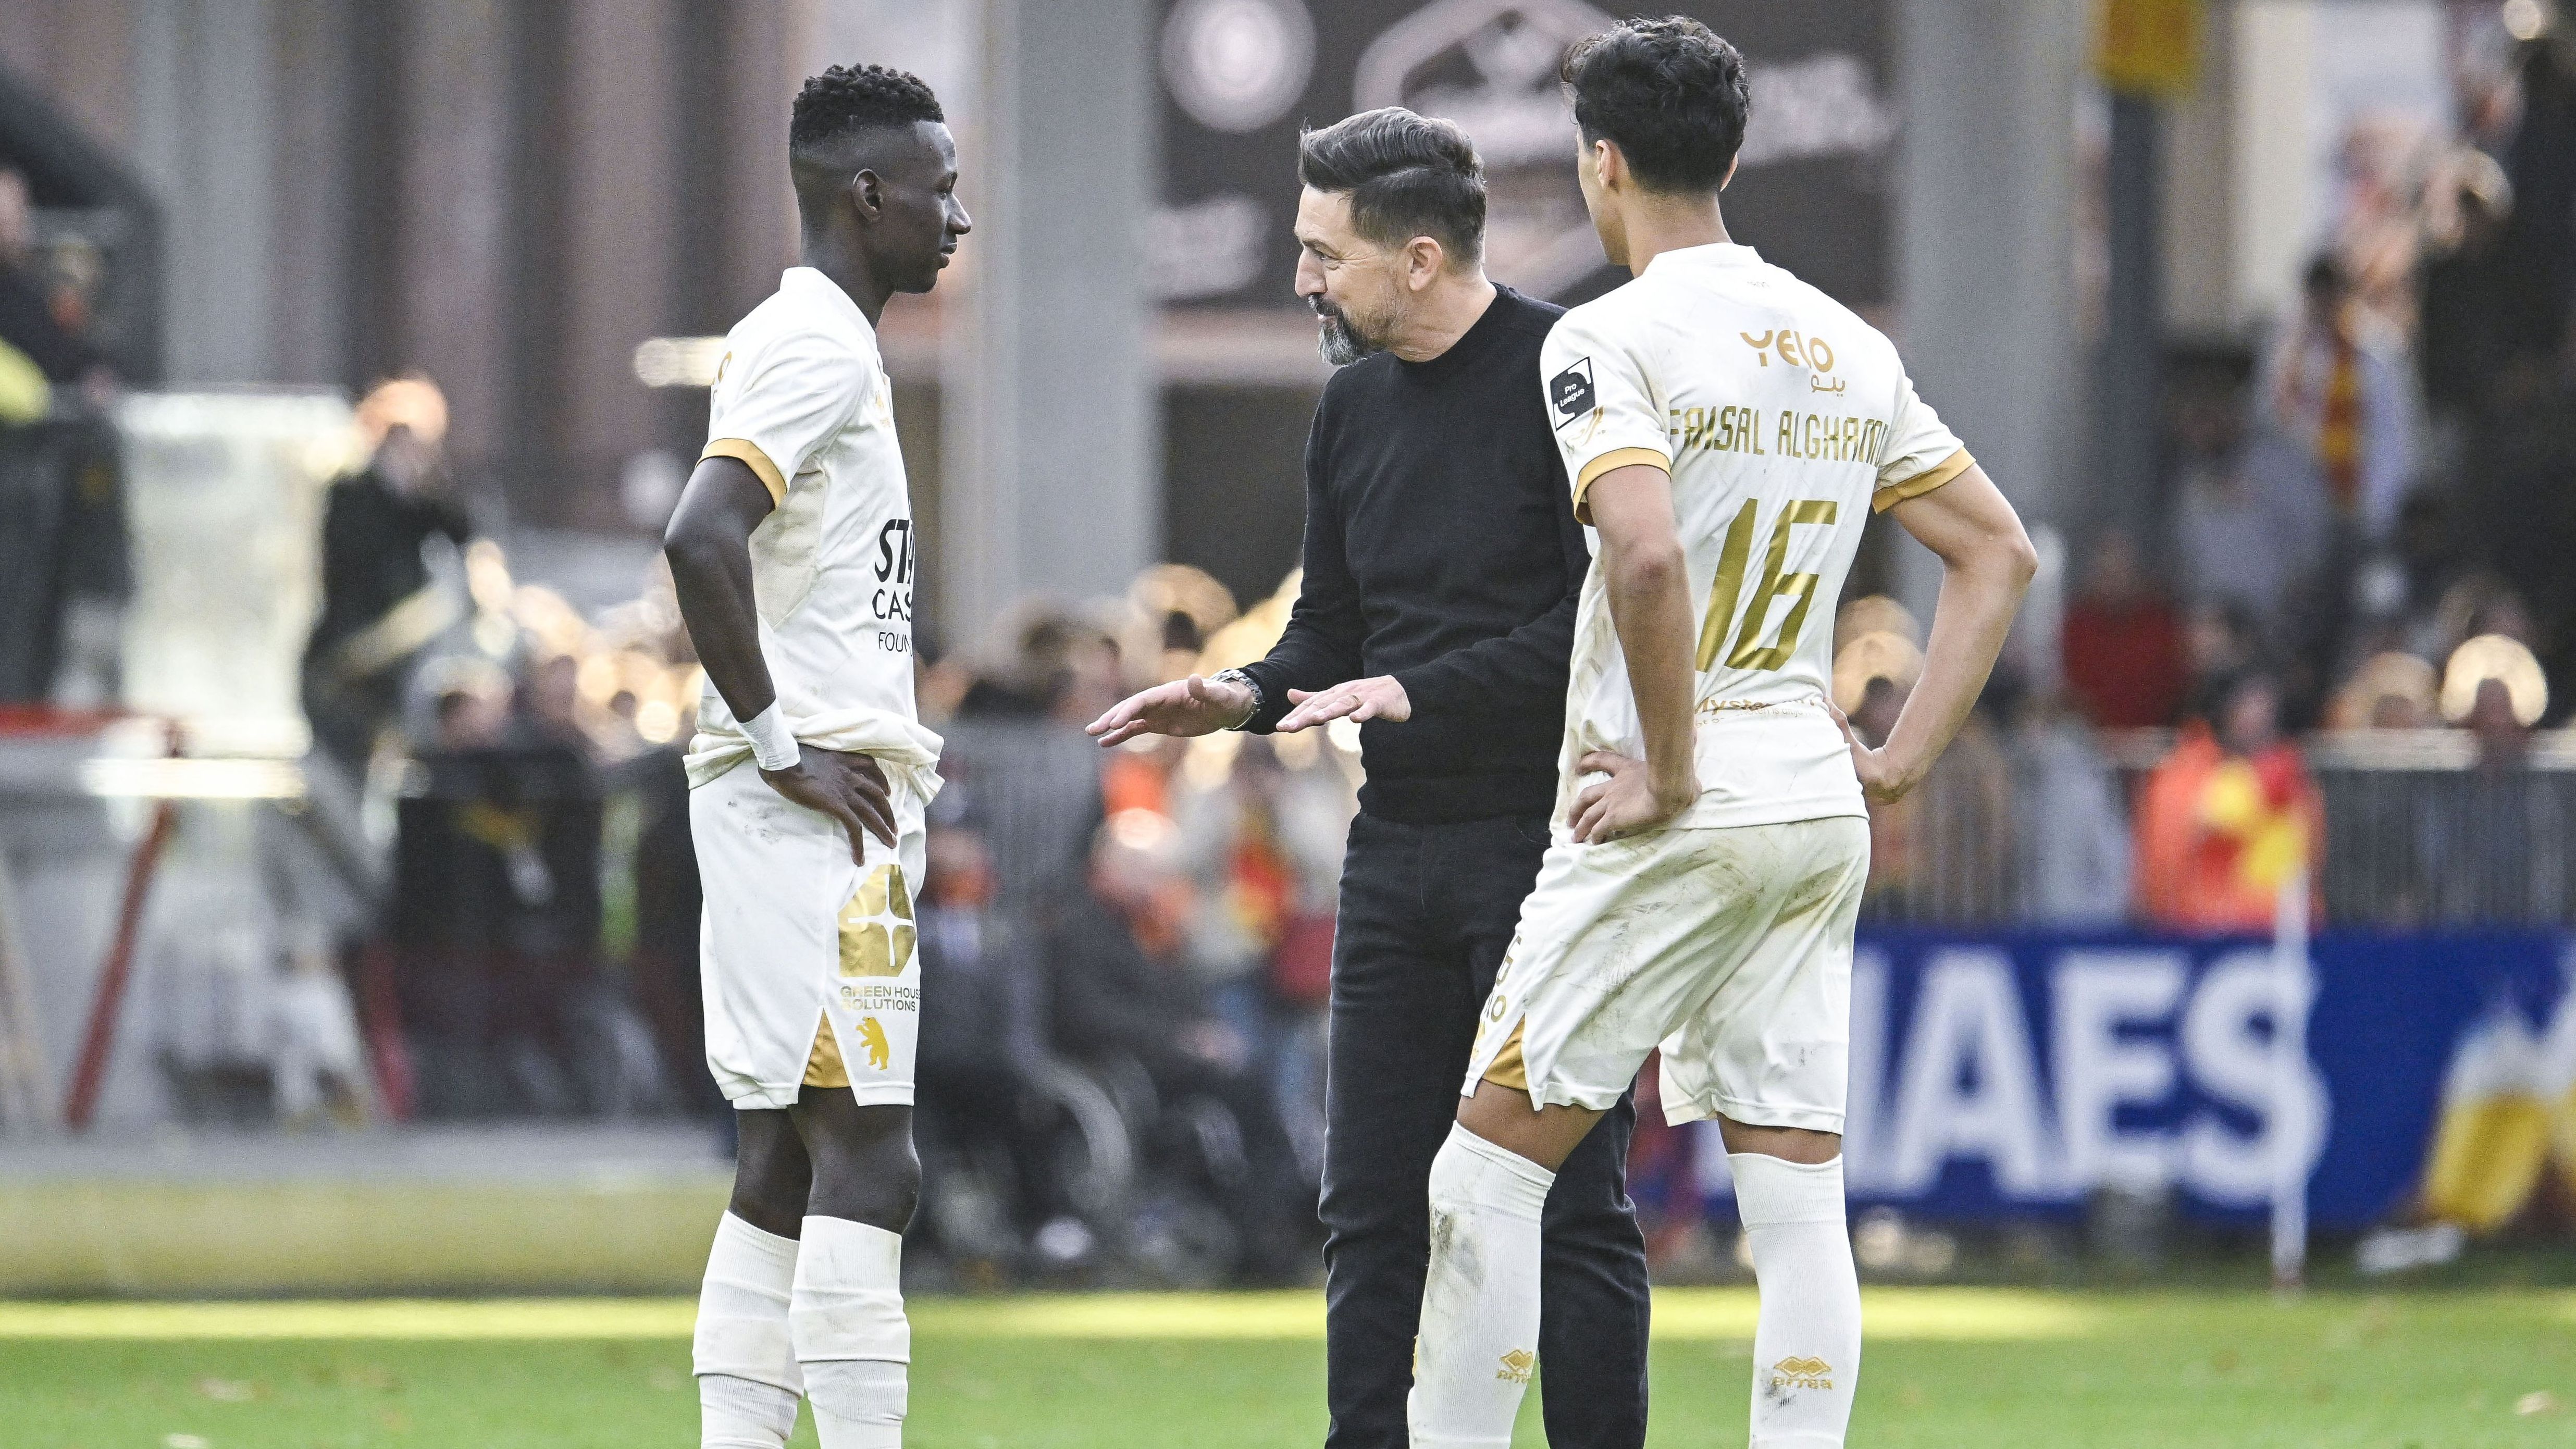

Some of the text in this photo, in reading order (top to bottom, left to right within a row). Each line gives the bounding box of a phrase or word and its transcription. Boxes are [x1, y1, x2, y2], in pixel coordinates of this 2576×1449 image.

[1560, 388, 1585, 407] League
[1564, 383, 1577, 394] Pro
[1777, 410, 1889, 467] ALGHAMD
[874, 518, 914, 584] STA
[1695, 498, 1838, 673] 16
[872, 588, 911, 622] CAS
[878, 631, 912, 657] FOUN
[840, 986, 921, 999] GREEN HOUS
[841, 998, 916, 1012] SOLUTIONS
